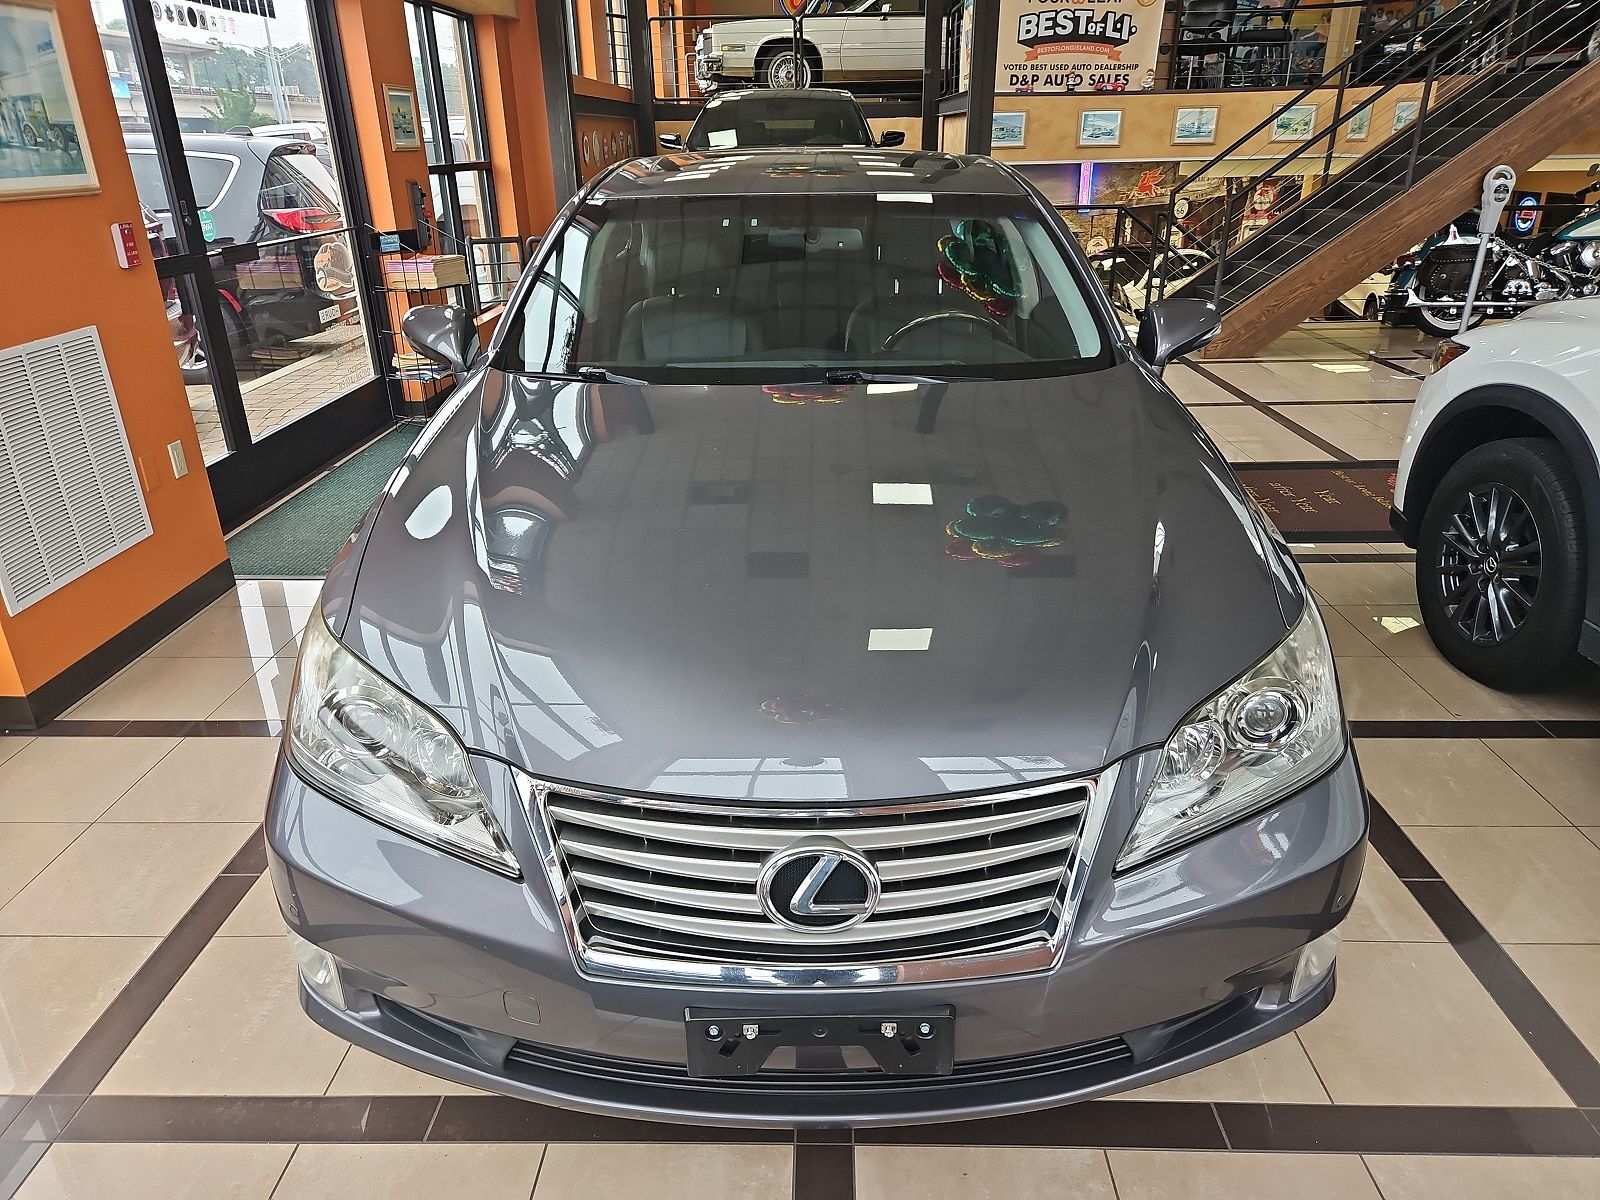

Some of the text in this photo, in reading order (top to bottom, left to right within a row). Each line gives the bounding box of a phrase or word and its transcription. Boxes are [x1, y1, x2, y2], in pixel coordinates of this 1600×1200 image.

[1019, 9, 1094, 41] BEST
[1003, 63, 1140, 71] VOTED BEST USED AUTO DEALERSHIP
[1009, 74, 1040, 86] D&P
